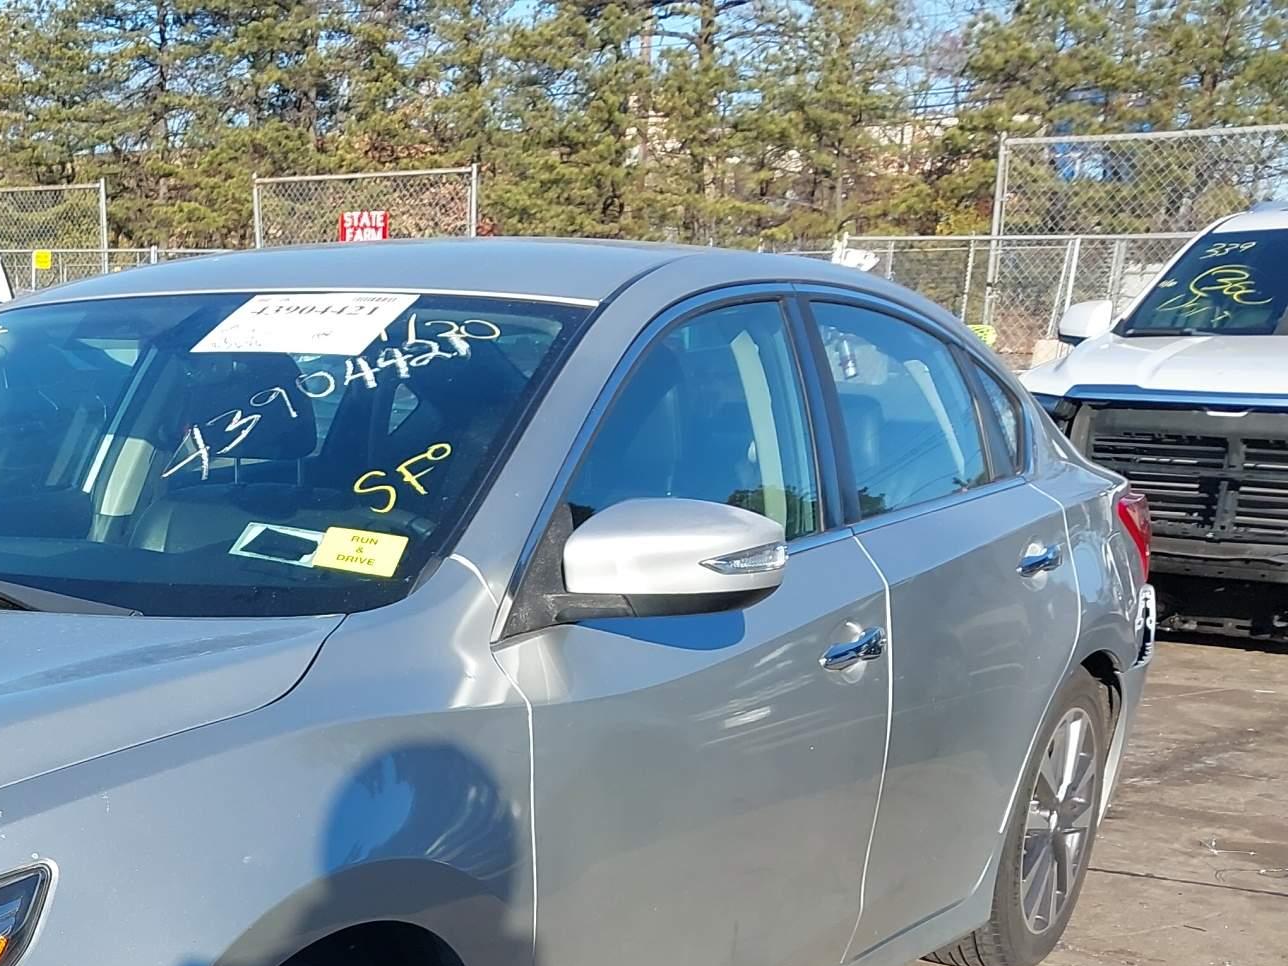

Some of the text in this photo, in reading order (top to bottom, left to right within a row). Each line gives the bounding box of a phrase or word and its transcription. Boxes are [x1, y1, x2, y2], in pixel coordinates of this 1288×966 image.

[344, 211, 385, 227] STATE
[346, 227, 383, 241] FARM
[350, 535, 379, 545] RUN
[355, 546, 364, 554] &
[335, 554, 376, 566] DRIVE
